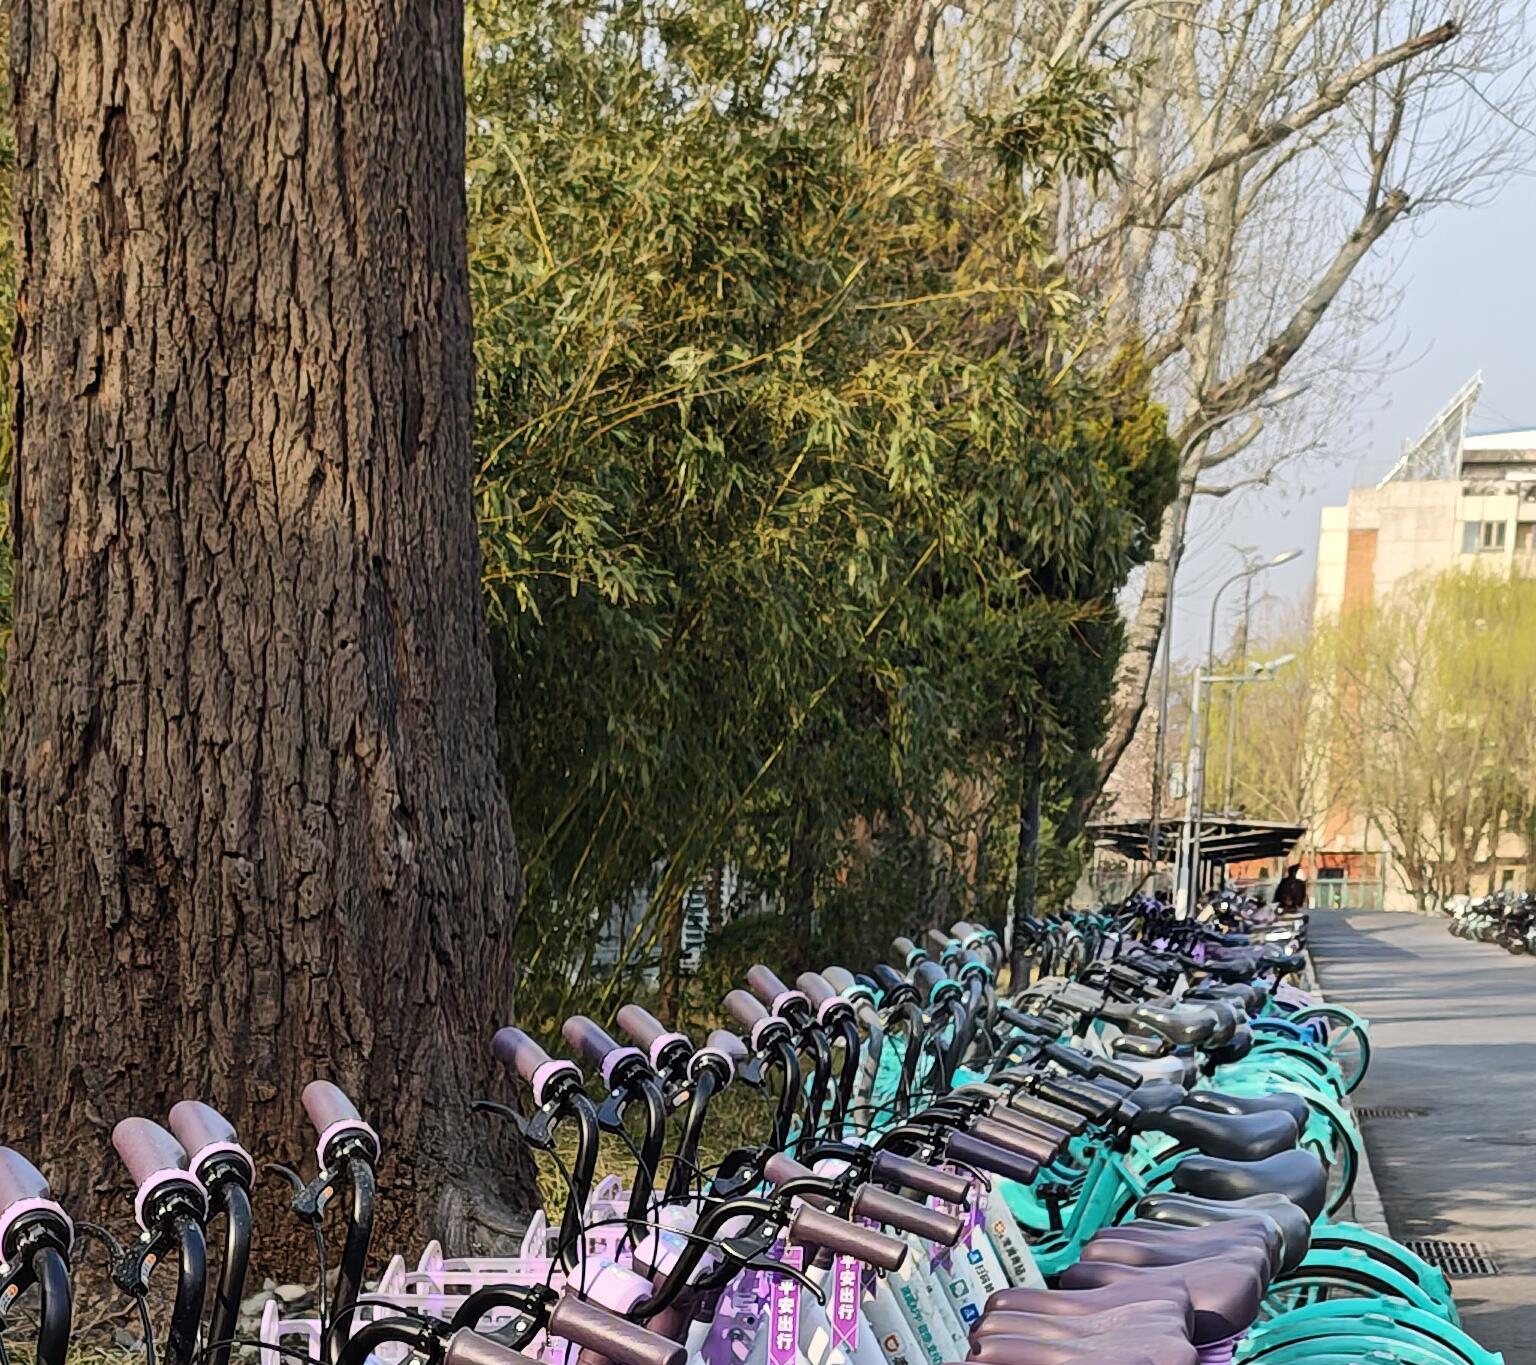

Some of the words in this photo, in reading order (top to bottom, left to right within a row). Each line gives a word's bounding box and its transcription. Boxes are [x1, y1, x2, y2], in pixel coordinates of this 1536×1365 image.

[776, 1280, 796, 1350] 平安出行
[838, 1256, 857, 1320] 平安出行
